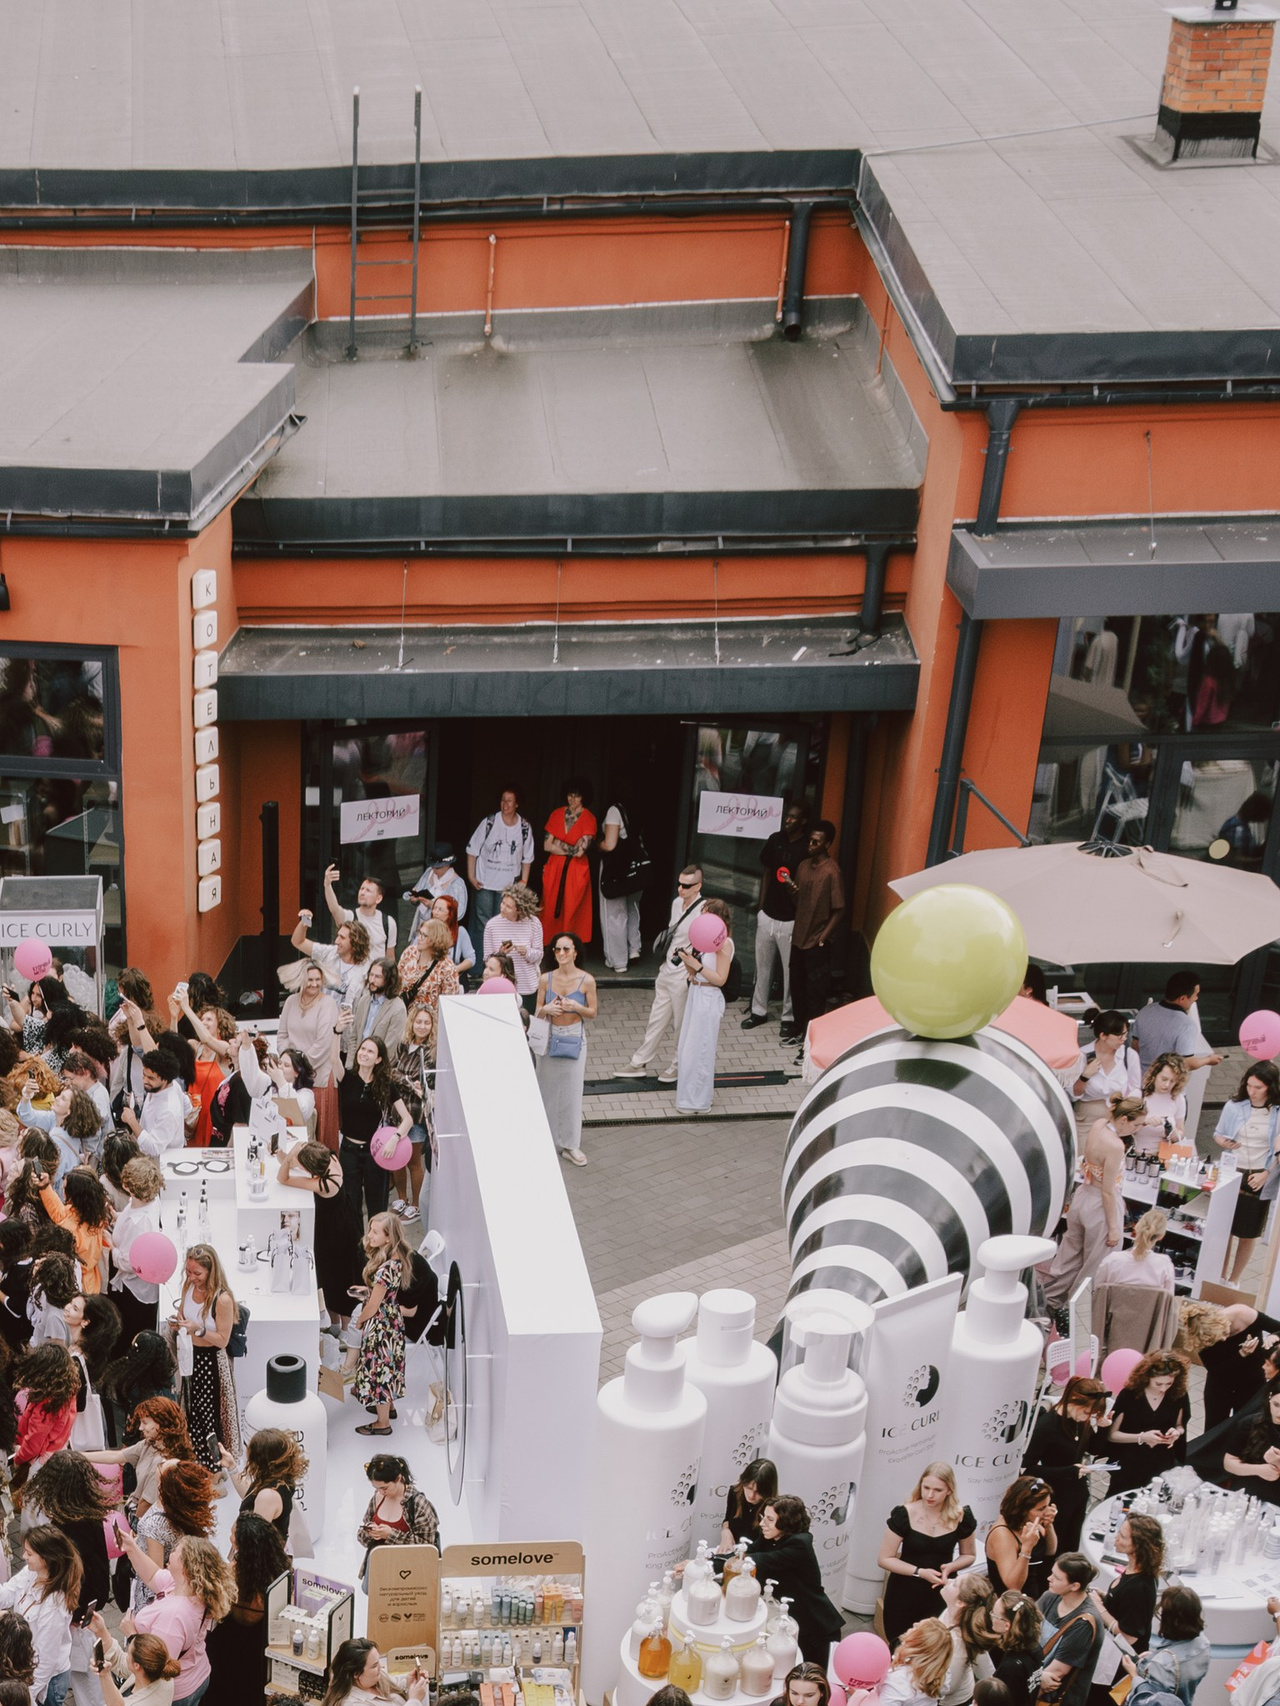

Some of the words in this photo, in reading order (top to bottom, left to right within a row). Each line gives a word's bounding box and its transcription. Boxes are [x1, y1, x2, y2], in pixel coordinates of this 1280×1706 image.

[204, 583, 218, 901] КОТЕЛЬНАЯ
[356, 808, 406, 822] ЛЕКТОРИЙ
[715, 805, 768, 817] ЛЕКТОРИЙ
[1, 923, 29, 938] ICE
[35, 922, 93, 937] CURLY
[955, 1454, 985, 1468] ICE
[709, 1485, 727, 1498] IC
[471, 1552, 554, 1566] somelove
[302, 1577, 347, 1598] somelove
